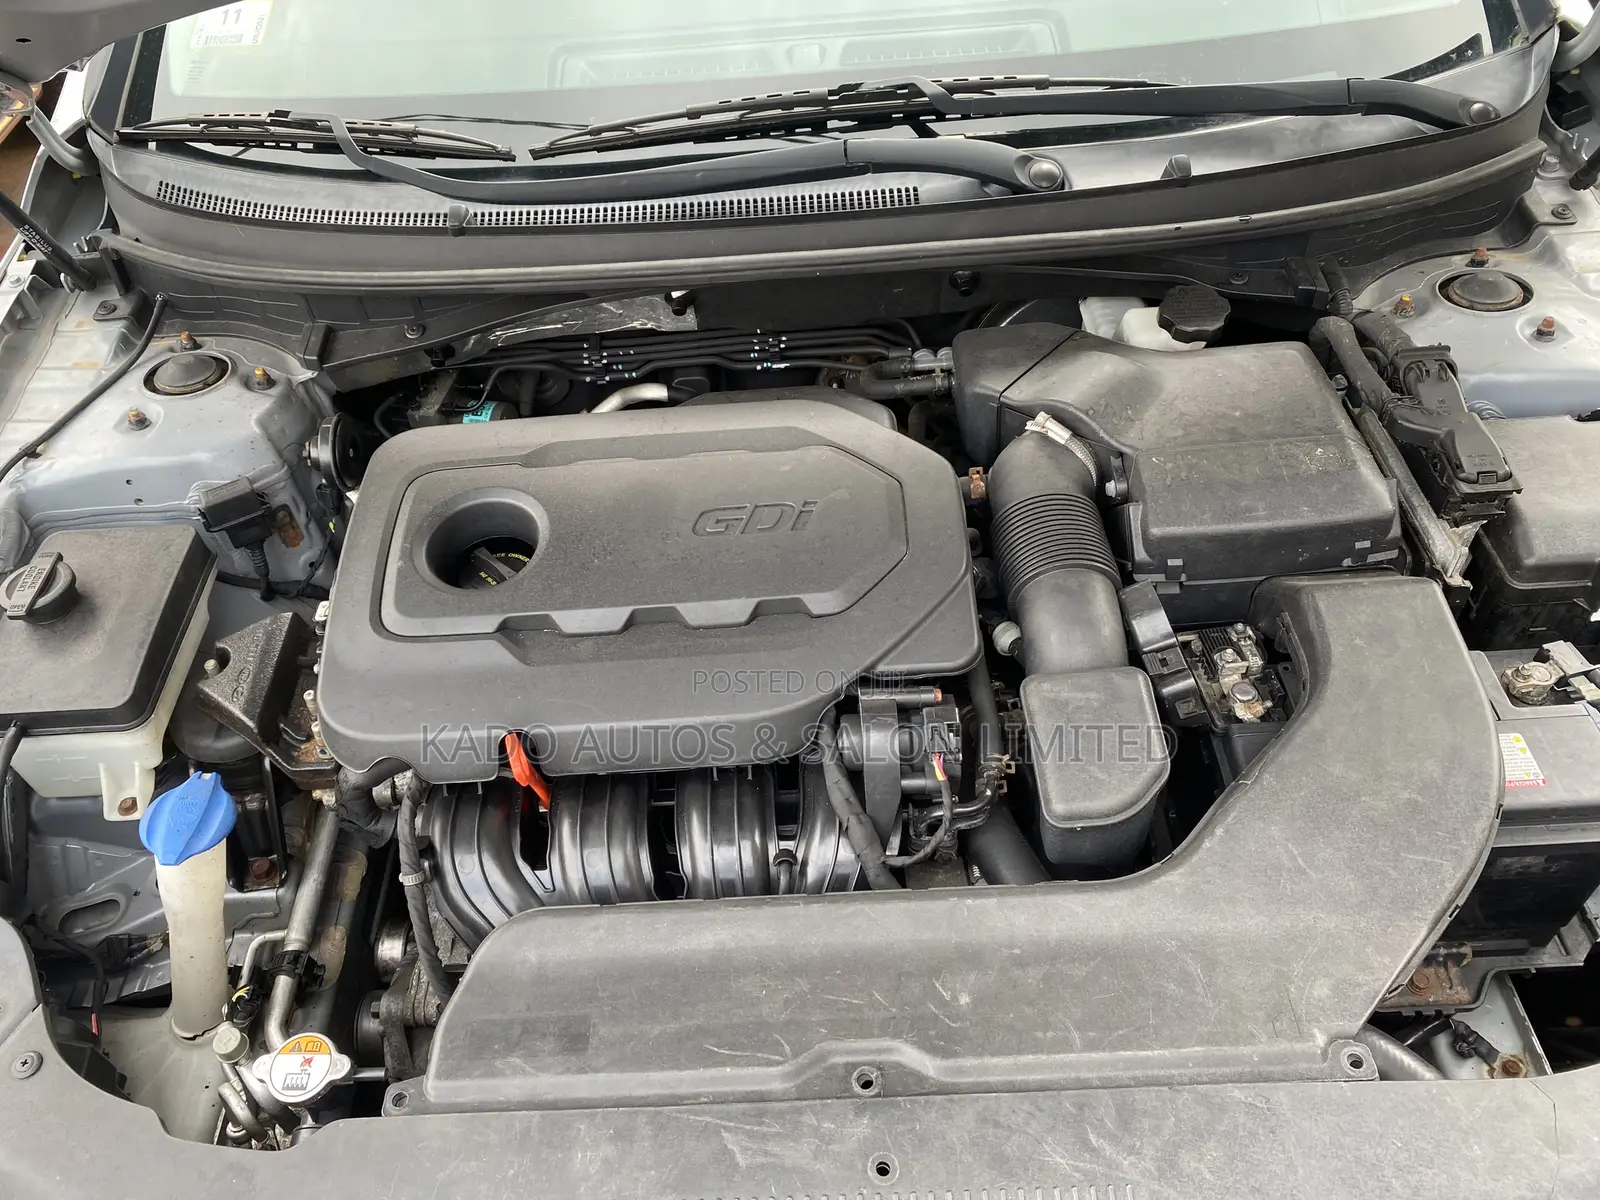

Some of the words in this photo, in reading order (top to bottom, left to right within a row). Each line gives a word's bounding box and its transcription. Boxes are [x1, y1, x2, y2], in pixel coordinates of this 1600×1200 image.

[222, 8, 243, 25] 11
[23, 224, 53, 252] STABILUS
[692, 499, 819, 538] GDi
